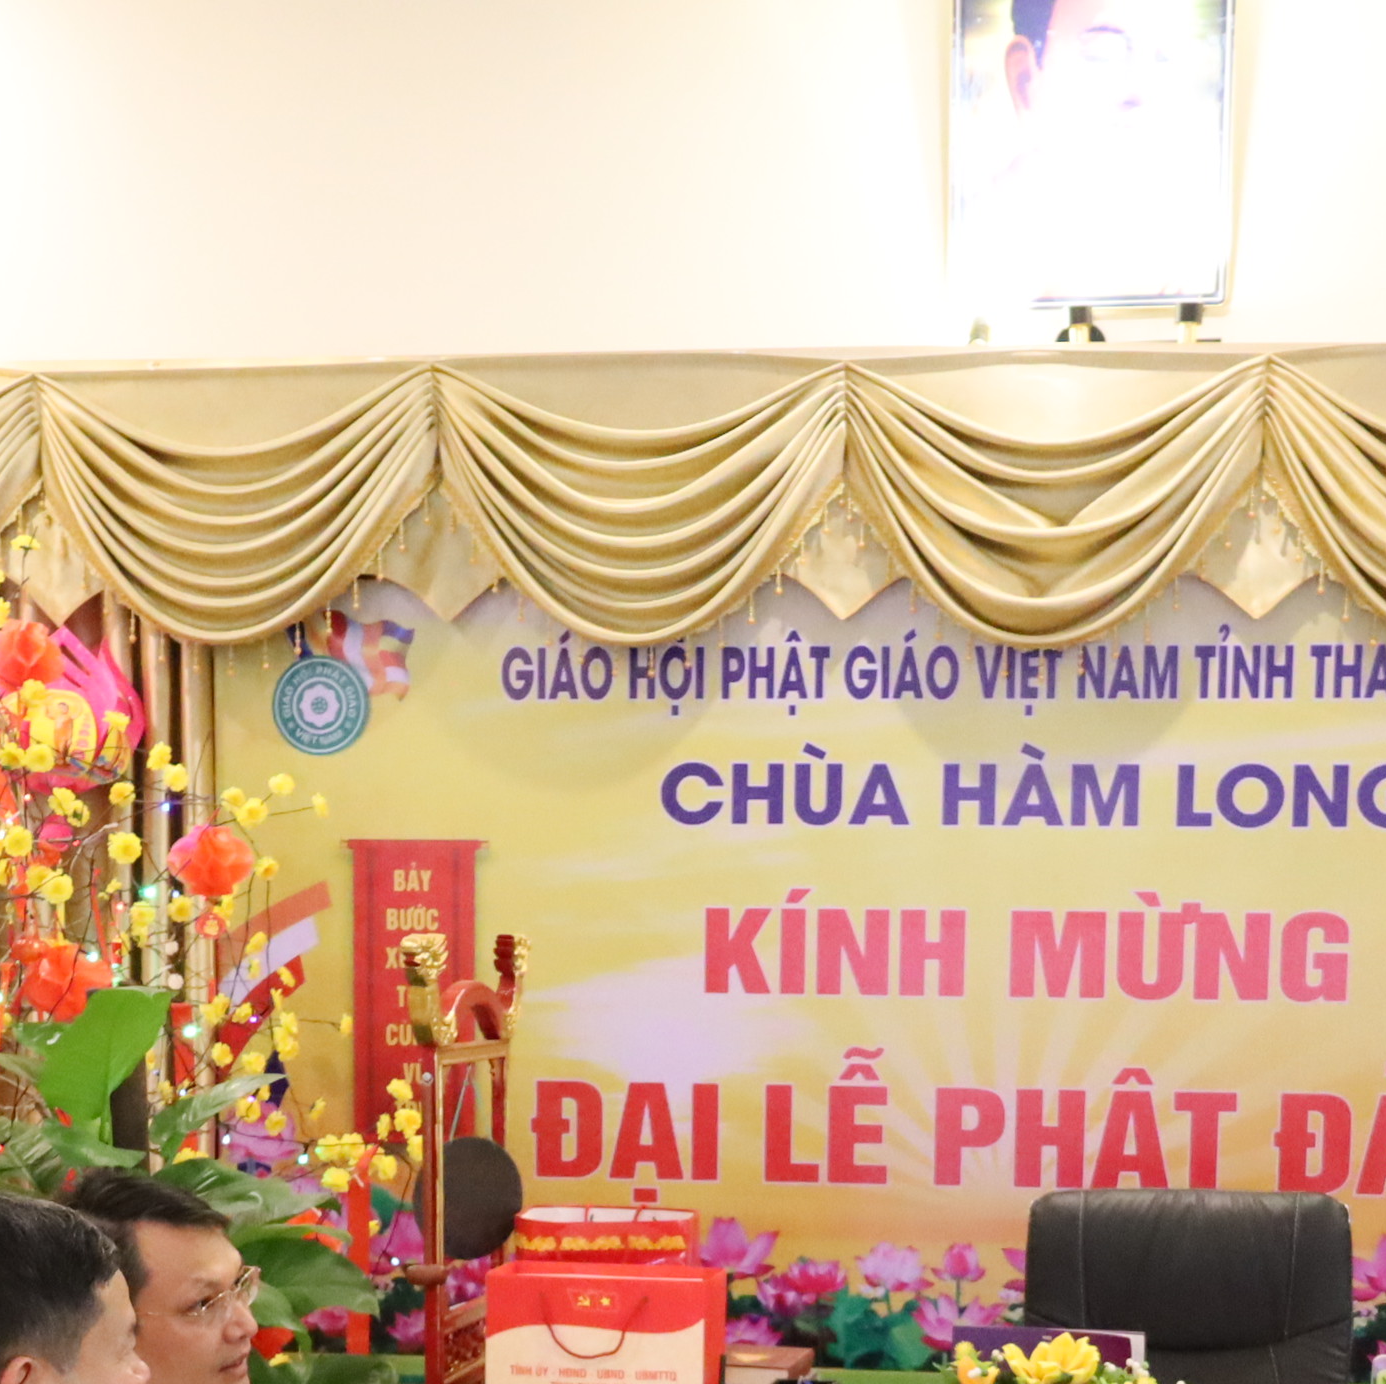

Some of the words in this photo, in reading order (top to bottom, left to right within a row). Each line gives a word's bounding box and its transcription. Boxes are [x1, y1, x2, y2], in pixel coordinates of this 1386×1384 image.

[501, 629, 613, 701] GIÁO
[628, 637, 706, 717] HỘI
[720, 628, 831, 717] PHẬT
[843, 627, 960, 701] GIÁO
[1076, 644, 1180, 700] NAM
[1194, 623, 1295, 700] TỈNH
[660, 742, 910, 826] CHÙA
[941, 742, 1141, 828] HÀM
[393, 862, 432, 893] BẢY
[704, 887, 968, 998] KÍNH
[1009, 890, 1352, 1002] MỪNG
[532, 1079, 721, 1204] ĐẠI
[764, 1046, 890, 1186] LỄ
